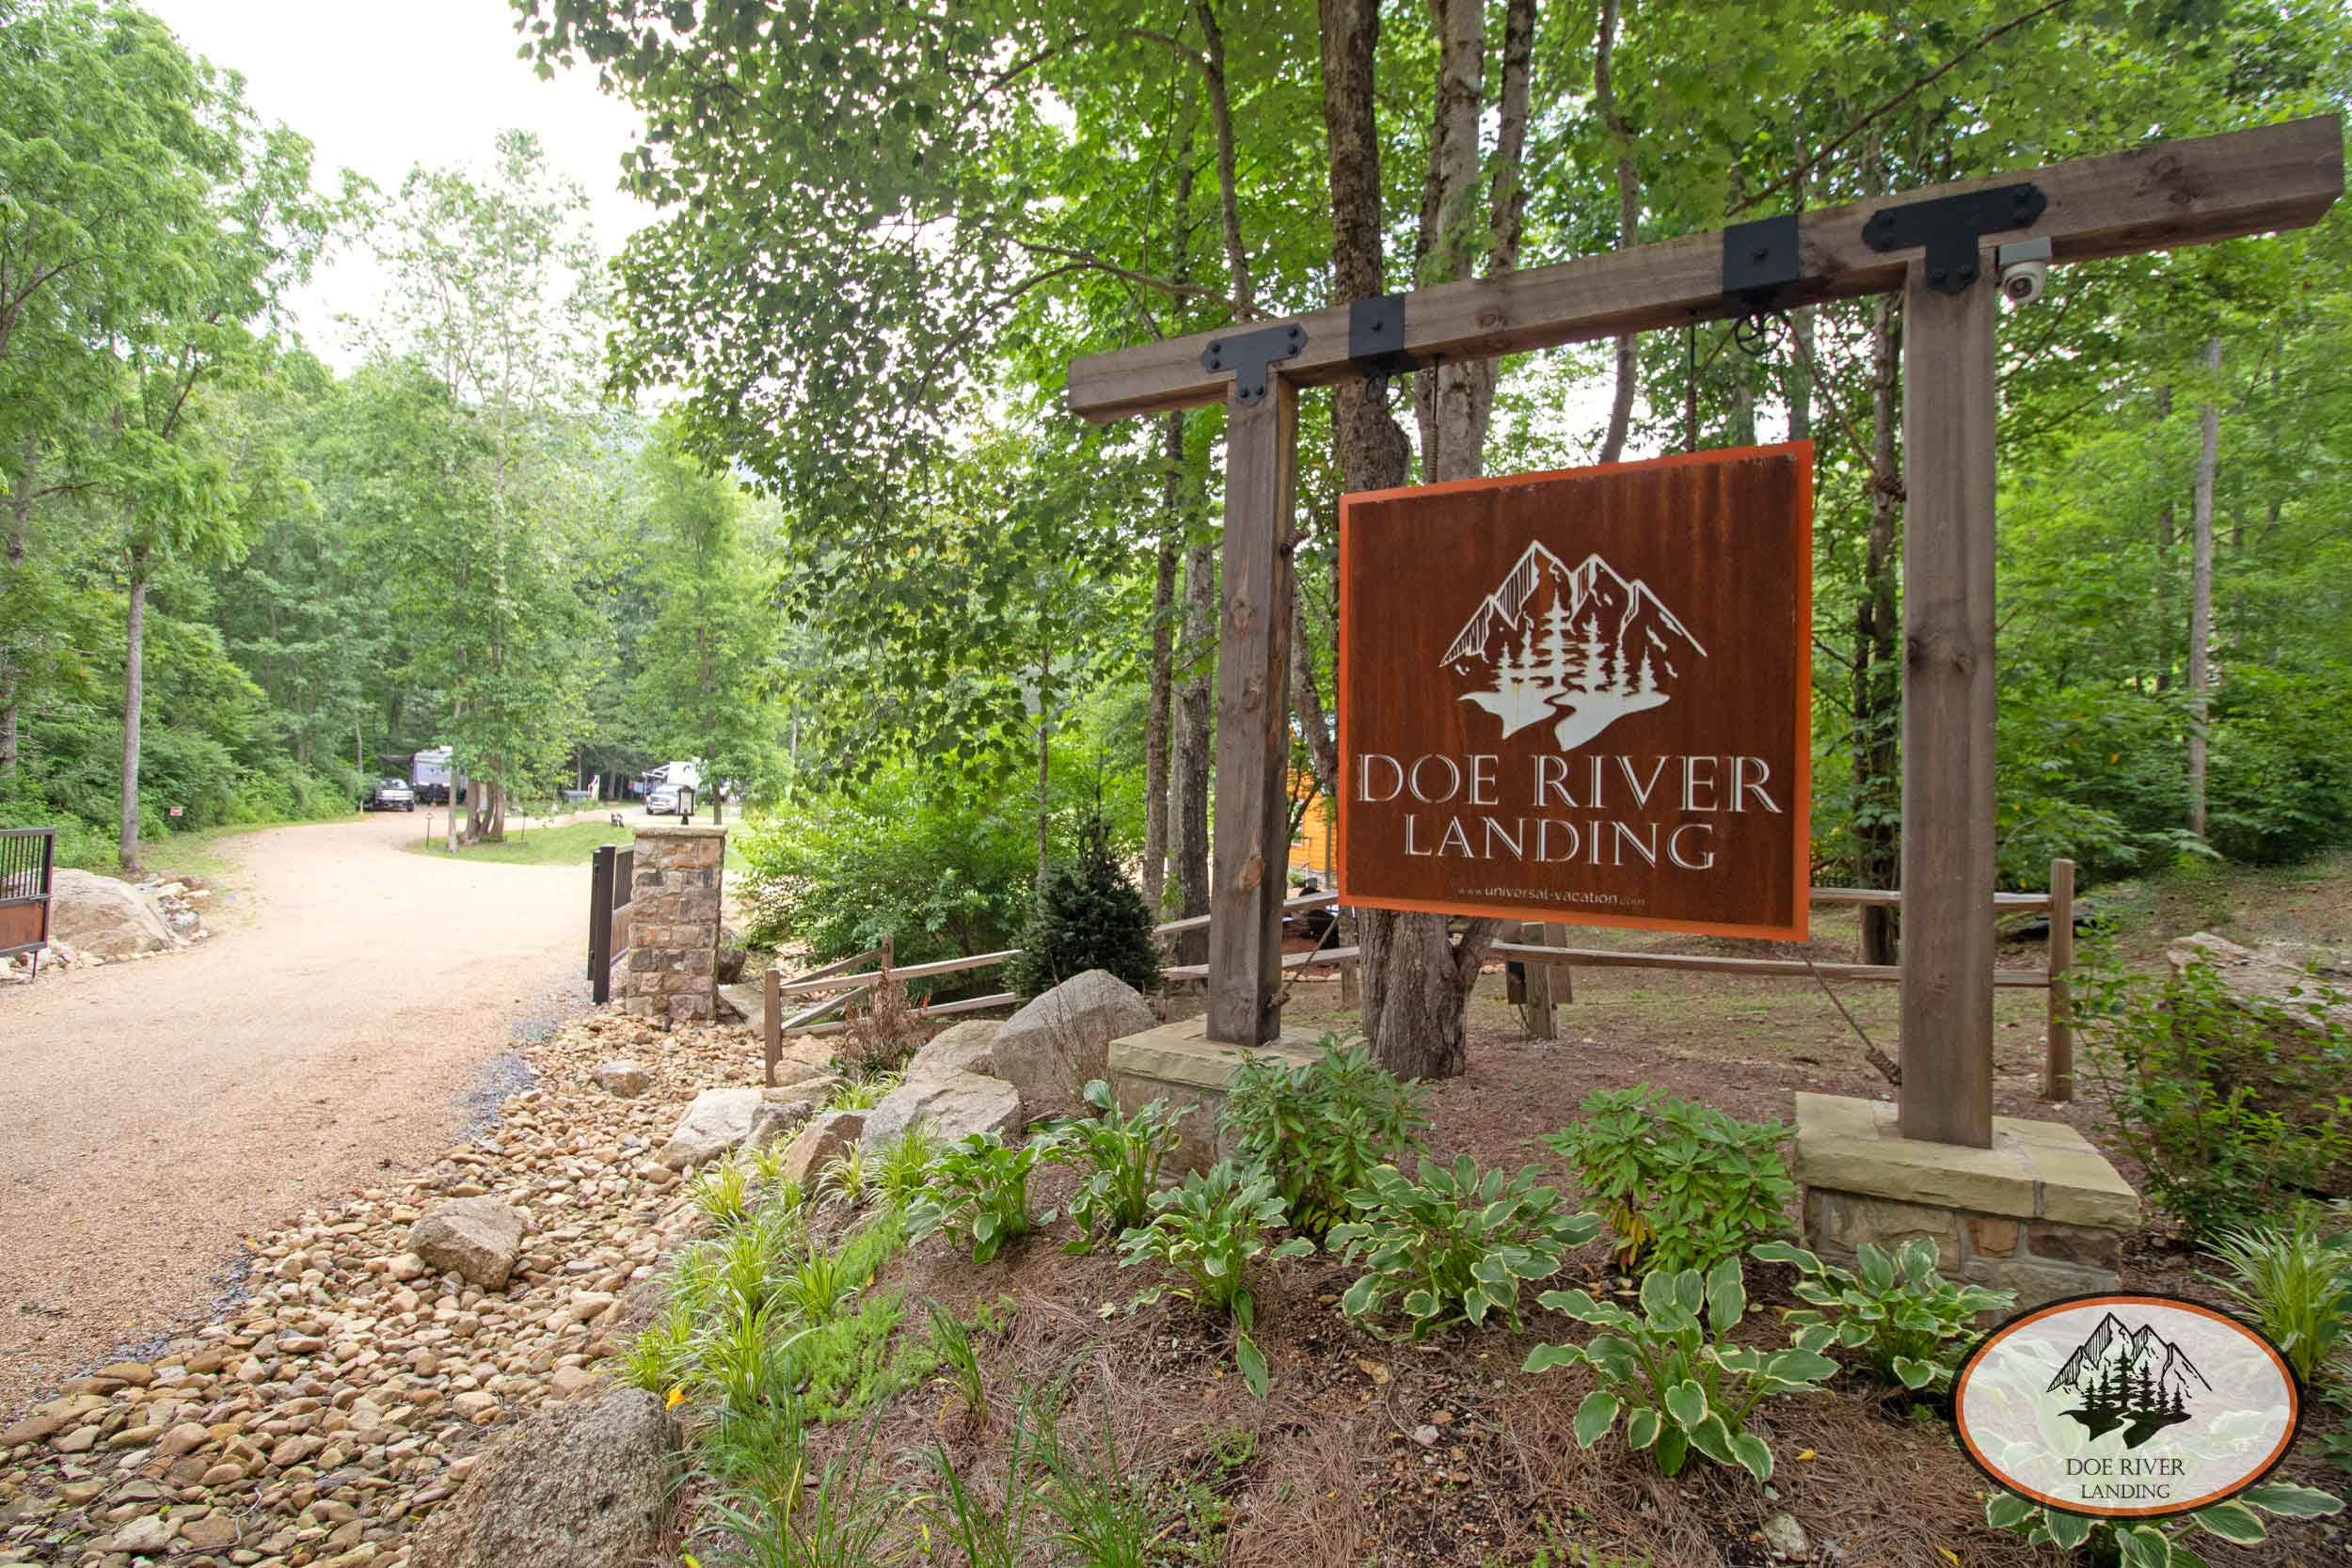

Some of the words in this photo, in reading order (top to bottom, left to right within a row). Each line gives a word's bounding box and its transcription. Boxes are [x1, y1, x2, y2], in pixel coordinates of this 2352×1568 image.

[1358, 753, 1500, 805] DOE
[1530, 754, 1784, 814] RIVER
[1404, 814, 1717, 870] LANDING
